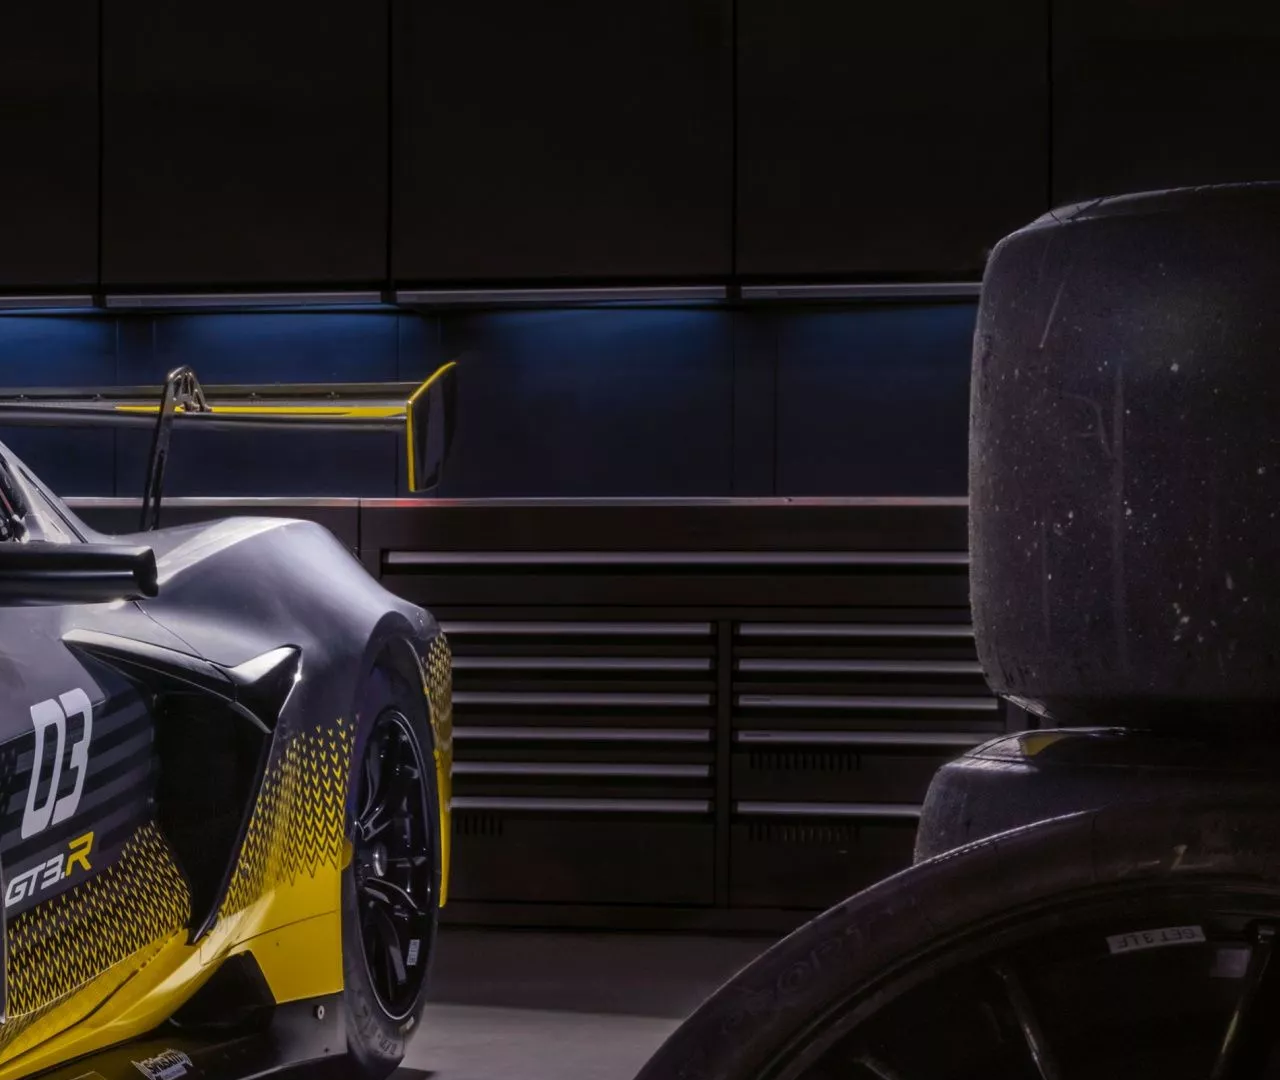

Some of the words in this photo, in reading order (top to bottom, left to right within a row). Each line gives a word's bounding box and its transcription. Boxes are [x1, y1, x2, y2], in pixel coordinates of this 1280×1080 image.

[21, 688, 93, 839] 03
[5, 831, 94, 908] GT3.R
[1160, 928, 1197, 942] SET
